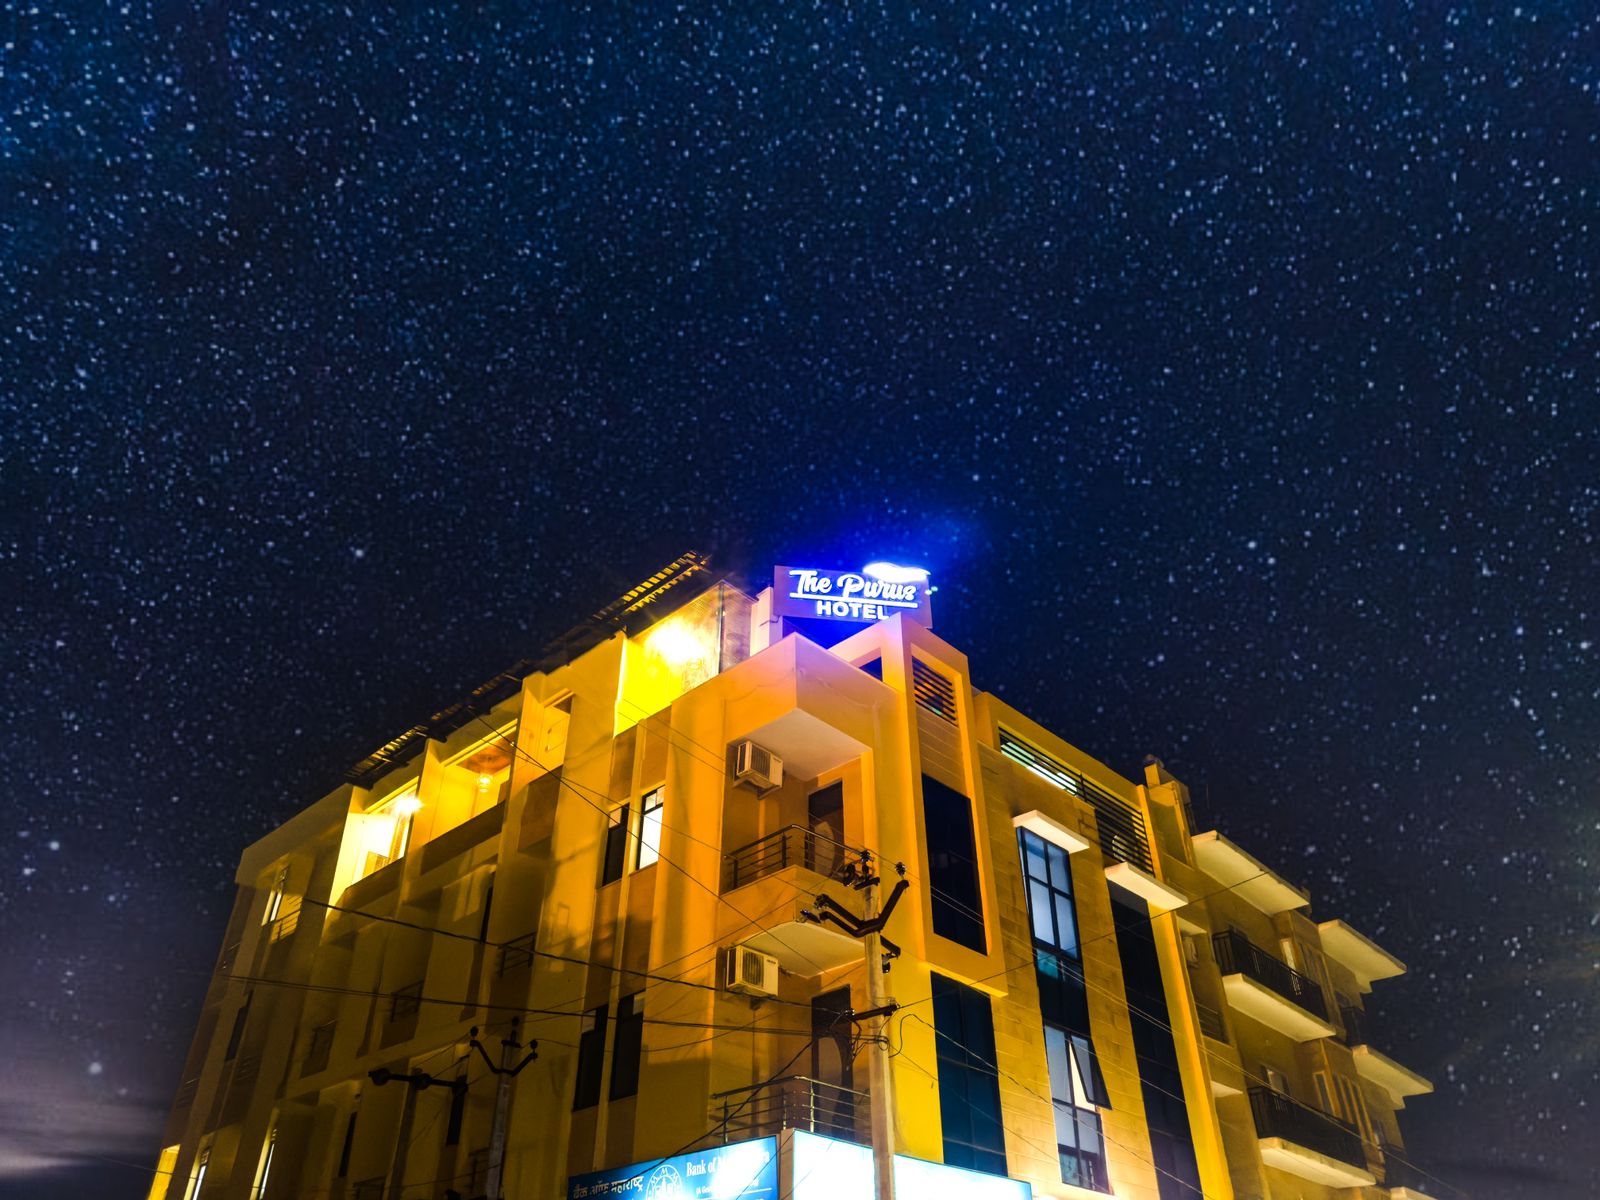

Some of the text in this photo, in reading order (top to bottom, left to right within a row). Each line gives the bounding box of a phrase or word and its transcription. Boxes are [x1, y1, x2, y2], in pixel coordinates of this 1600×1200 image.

[789, 570, 917, 601] The Purus
[816, 600, 890, 620] HOTEL
[686, 1159, 706, 1177] Bank
[707, 1157, 717, 1173] of
